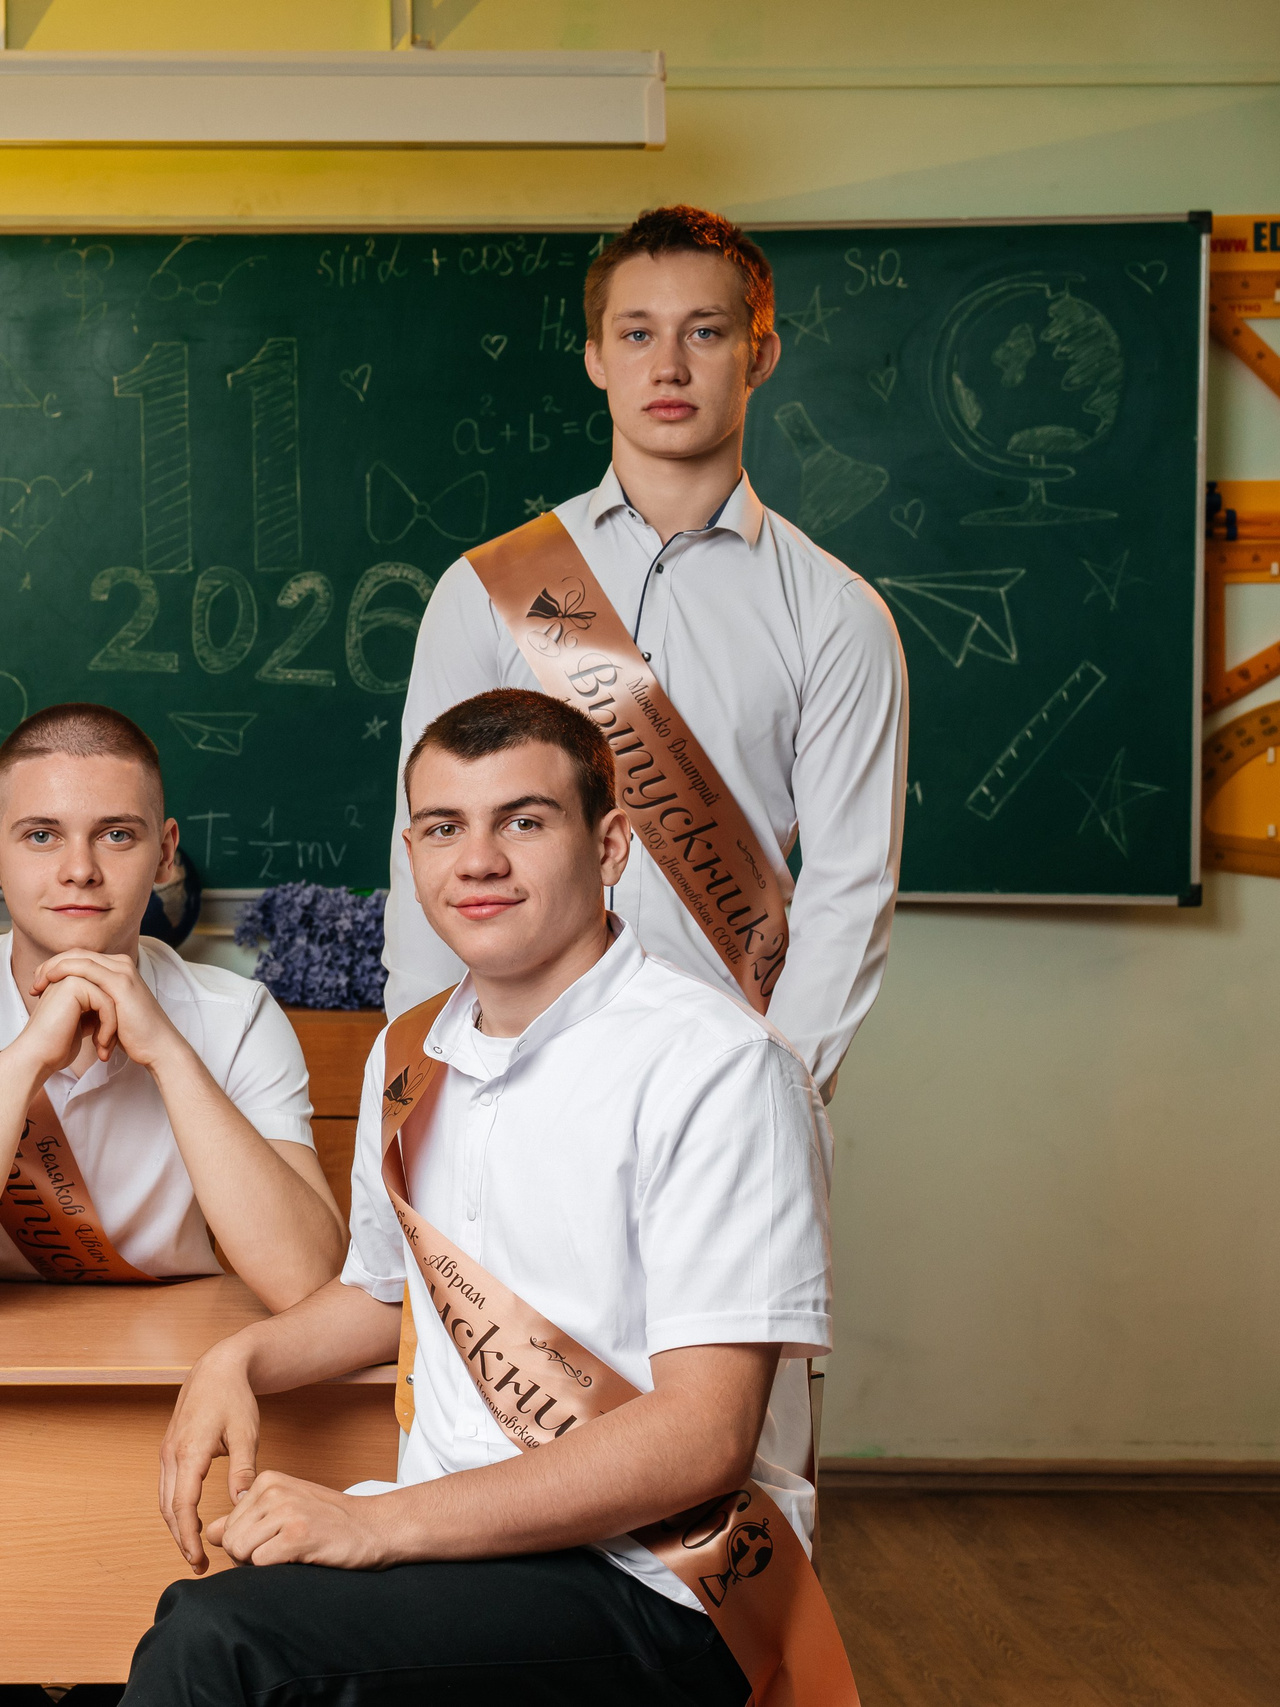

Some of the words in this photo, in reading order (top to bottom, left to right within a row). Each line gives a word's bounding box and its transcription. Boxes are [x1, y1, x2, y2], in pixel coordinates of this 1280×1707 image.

[86, 561, 438, 695] 2026
[626, 676, 671, 739] Миненко
[667, 737, 721, 808] Дмитрий
[35, 1135, 86, 1217] Беляков
[74, 1223, 110, 1264] Иван
